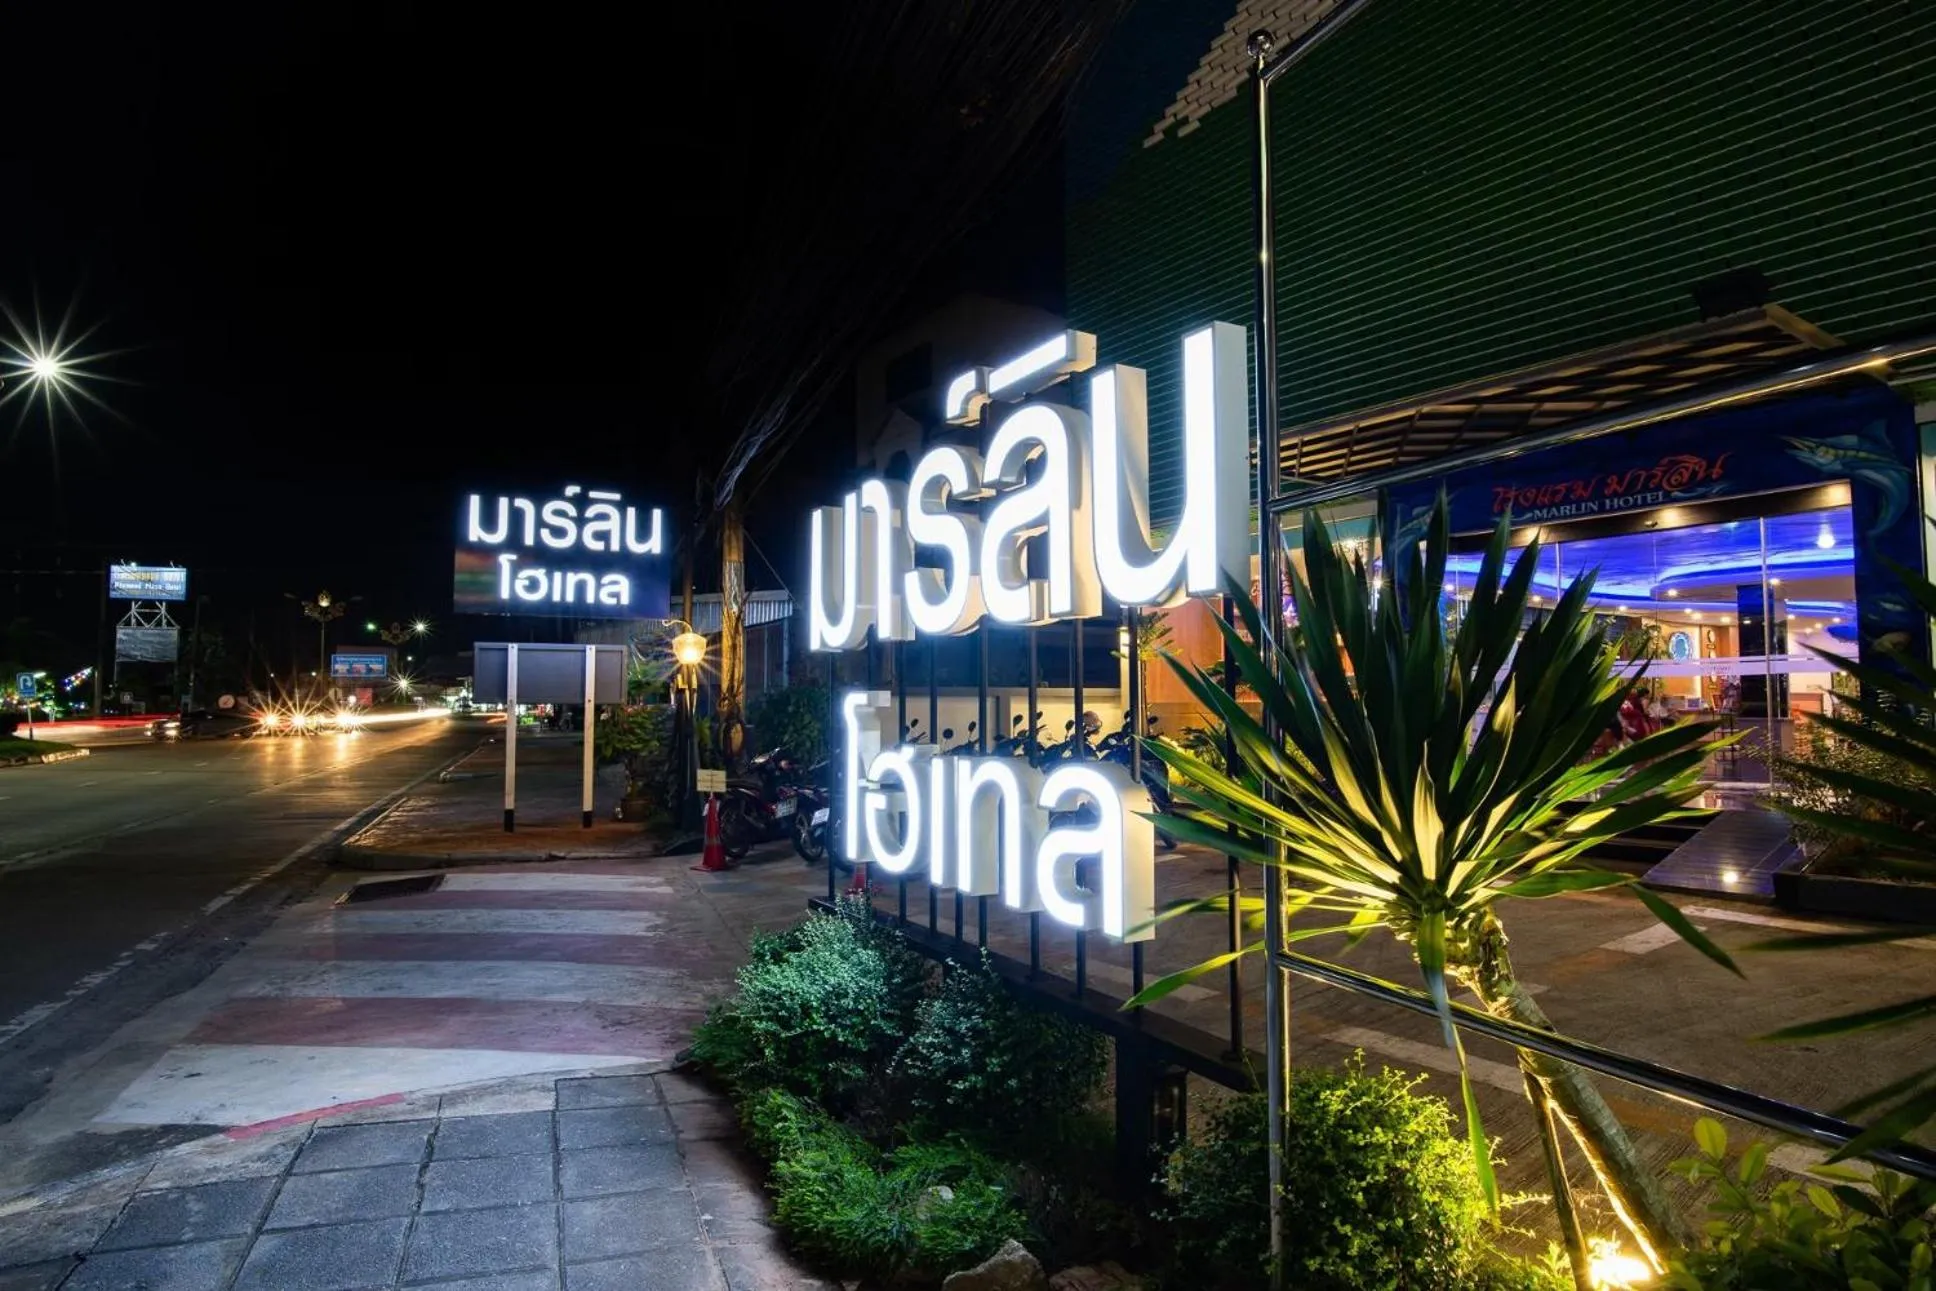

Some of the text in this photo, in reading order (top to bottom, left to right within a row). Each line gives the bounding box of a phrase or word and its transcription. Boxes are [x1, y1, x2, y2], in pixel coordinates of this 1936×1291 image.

[468, 485, 663, 555] มาร์ลิน
[810, 327, 1217, 652] มาร์ลิน
[1532, 490, 1666, 521] MARLIN HOTEL
[498, 553, 631, 606] โฮเทล
[844, 692, 1124, 939] โฮเทล
